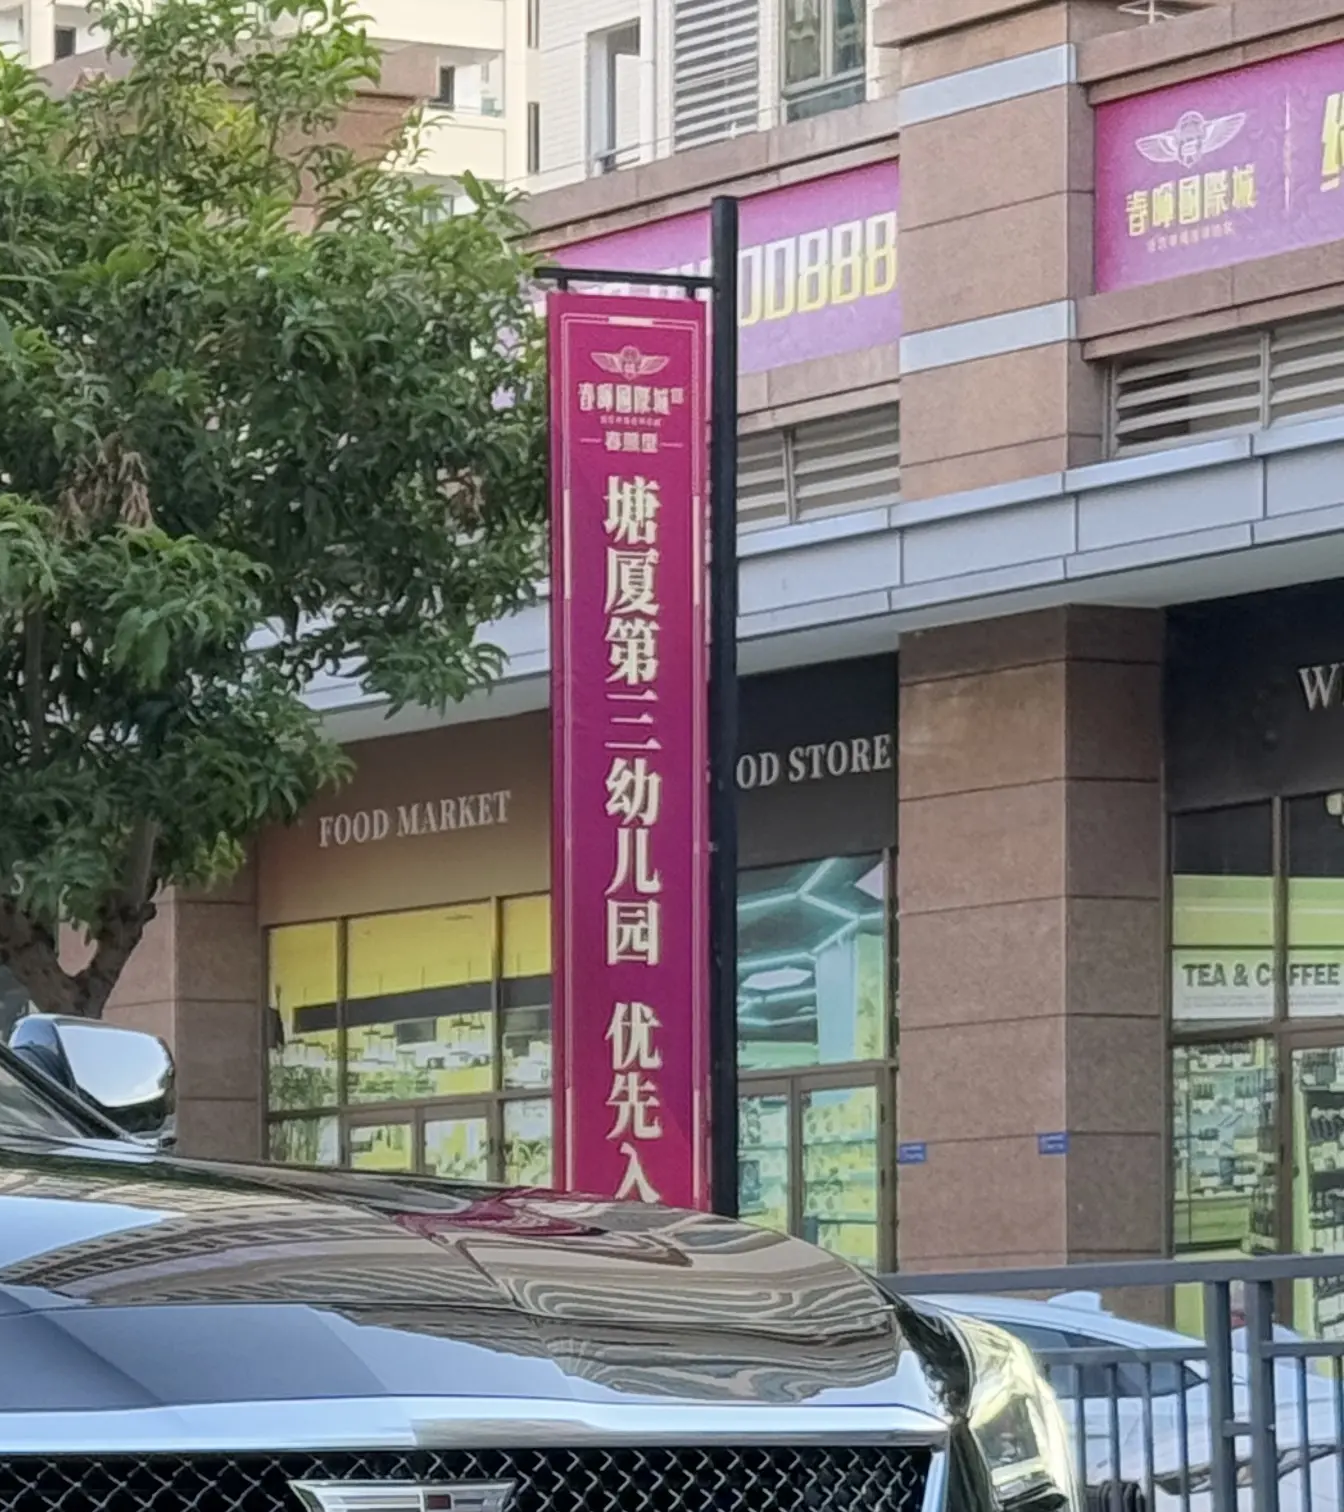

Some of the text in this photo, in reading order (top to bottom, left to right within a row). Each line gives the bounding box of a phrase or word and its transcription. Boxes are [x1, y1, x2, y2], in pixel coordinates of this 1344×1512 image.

[738, 211, 897, 326] 00888
[603, 475, 662, 967] 塘厦第三幼儿园
[787, 733, 892, 783] STORE
[319, 789, 511, 848] FOOD MARKET
[1182, 962, 1342, 988] TEA & CFFEE
